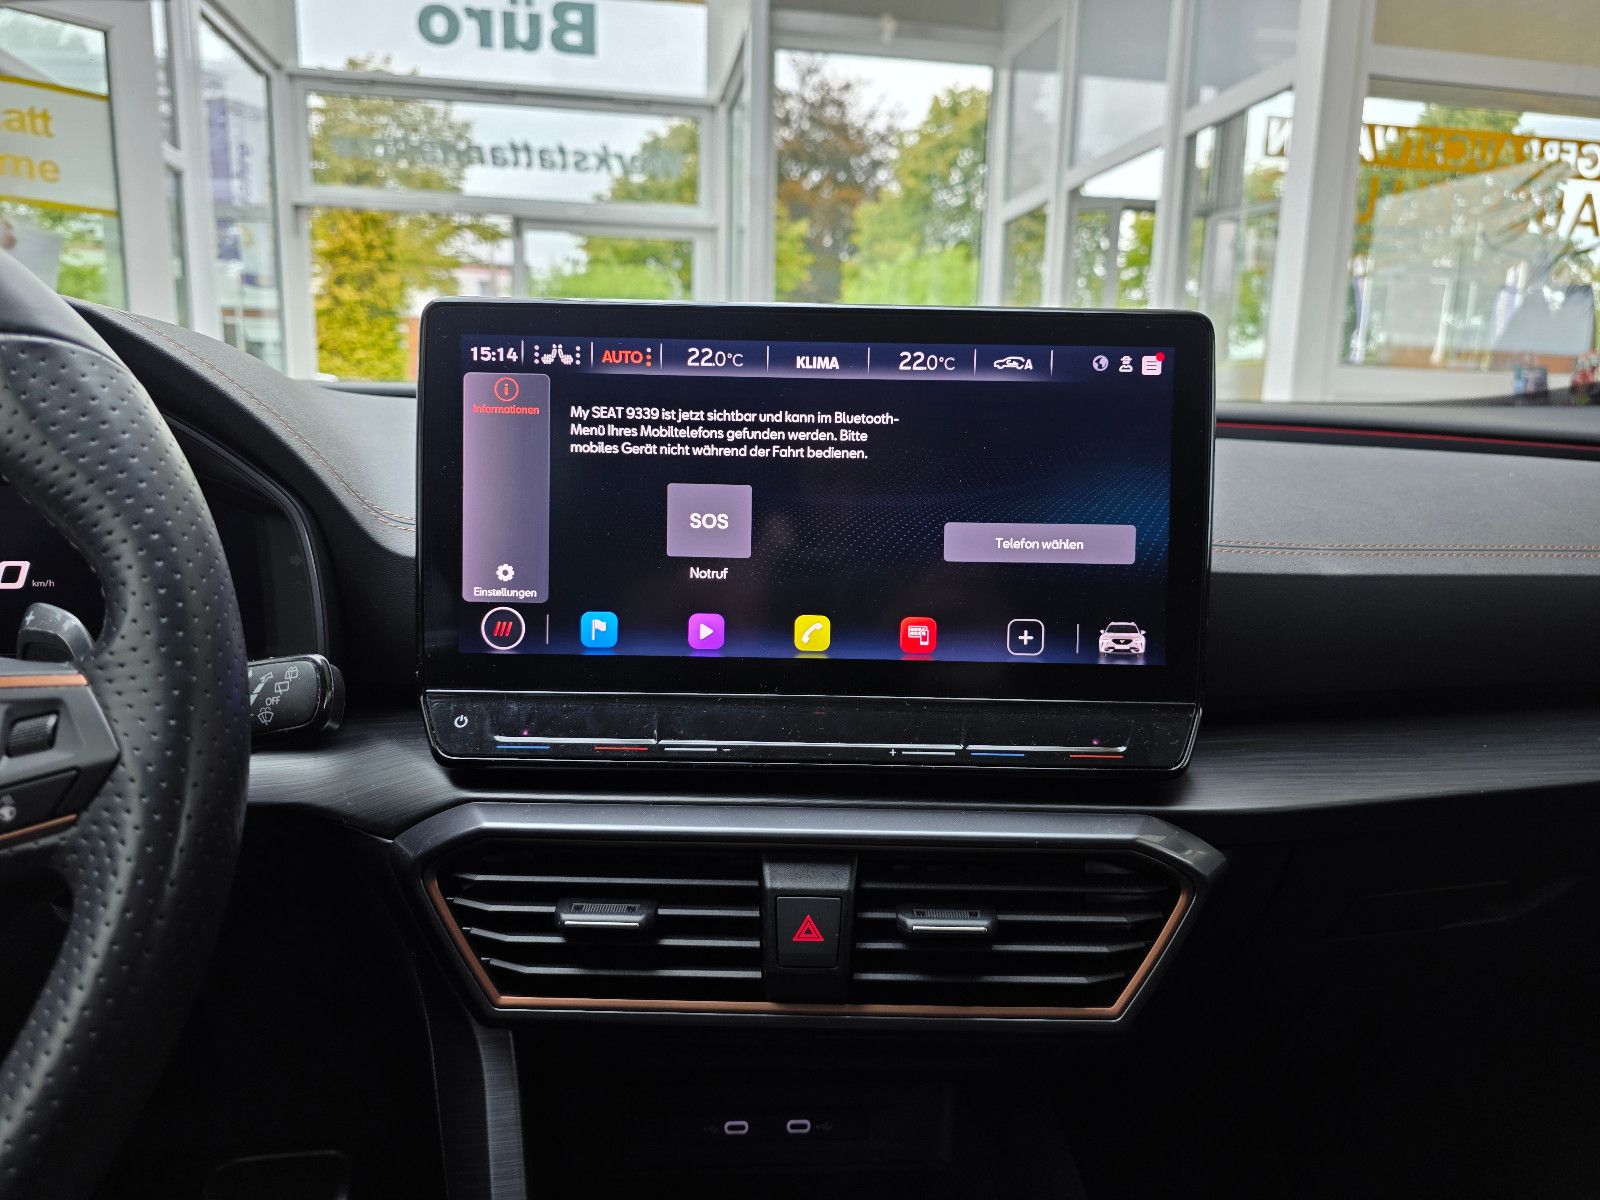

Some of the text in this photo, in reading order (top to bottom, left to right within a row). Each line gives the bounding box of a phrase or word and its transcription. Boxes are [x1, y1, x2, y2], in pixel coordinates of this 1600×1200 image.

[470, 346, 519, 362] 15:14
[602, 350, 643, 364] AUTO
[795, 355, 840, 371] KLIMA
[472, 403, 540, 415] Informationen
[570, 405, 900, 425] My SEAT 9339 ist jetzt sichtbar und kann im Bluetooth-
[570, 423, 868, 442] Menü Ihres Mobiltelefons gefunden werden. Bitte
[570, 441, 868, 459] mobiles Gerät nicht während der Fahrt bedienen.
[689, 513, 729, 530] SOS
[995, 537, 1084, 550] Telefon wählen
[689, 566, 729, 580] Notruf
[32, 579, 55, 588] km/h
[473, 586, 537, 599] Einstellungen
[265, 695, 281, 706] OFF
